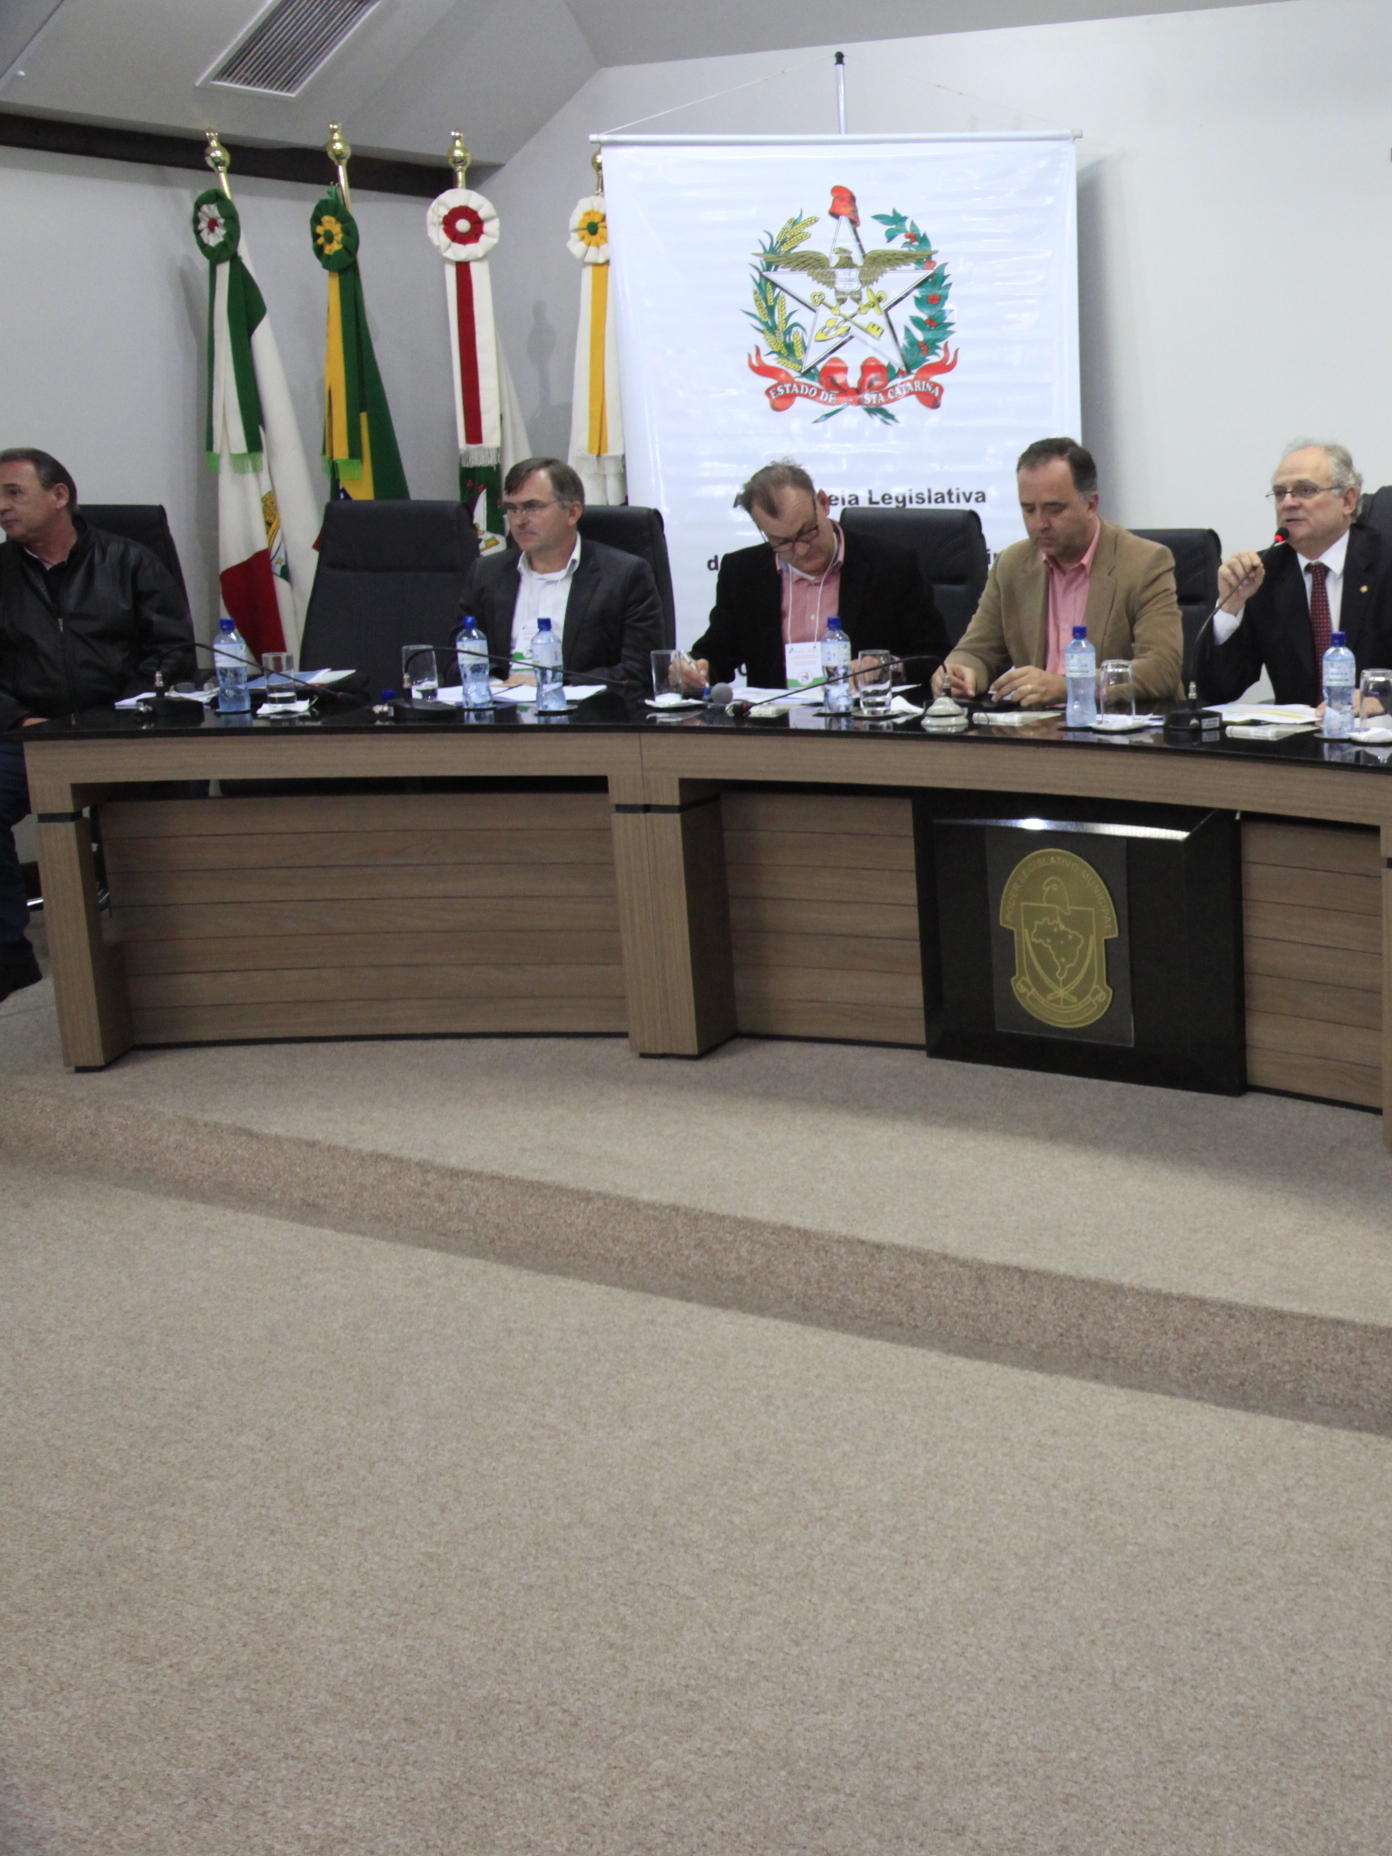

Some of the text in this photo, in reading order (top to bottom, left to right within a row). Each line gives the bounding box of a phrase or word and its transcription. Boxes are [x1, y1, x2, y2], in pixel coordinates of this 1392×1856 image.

[768, 383, 818, 399] ESTADO
[820, 391, 836, 404] DE
[888, 382, 940, 399] CATARINA
[868, 488, 987, 508] Legislativa
[1005, 856, 1112, 930] PODER LEGISLATIVO MUNICIPAL
